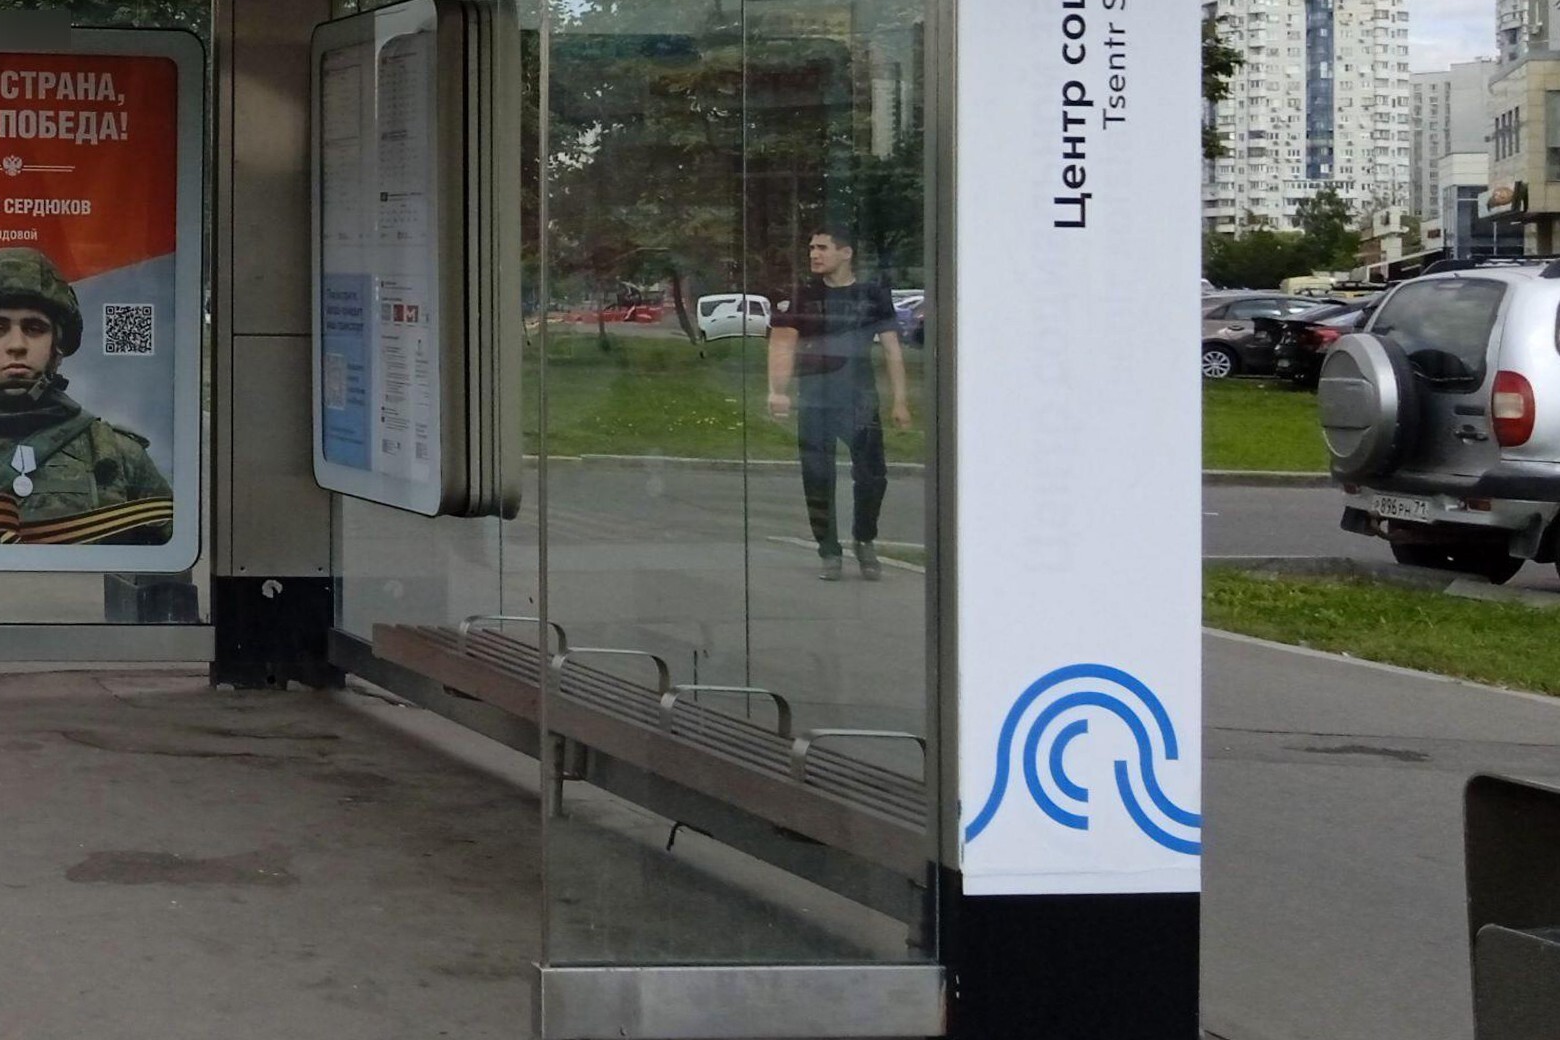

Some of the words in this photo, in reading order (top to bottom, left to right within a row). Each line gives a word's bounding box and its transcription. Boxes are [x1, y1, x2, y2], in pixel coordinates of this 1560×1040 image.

[0, 69, 125, 106] СТРАНА,
[1102, 21, 1127, 130] Tsentr
[1053, 79, 1094, 229] Центр
[4, 197, 92, 217] СЕРДЮКОВ
